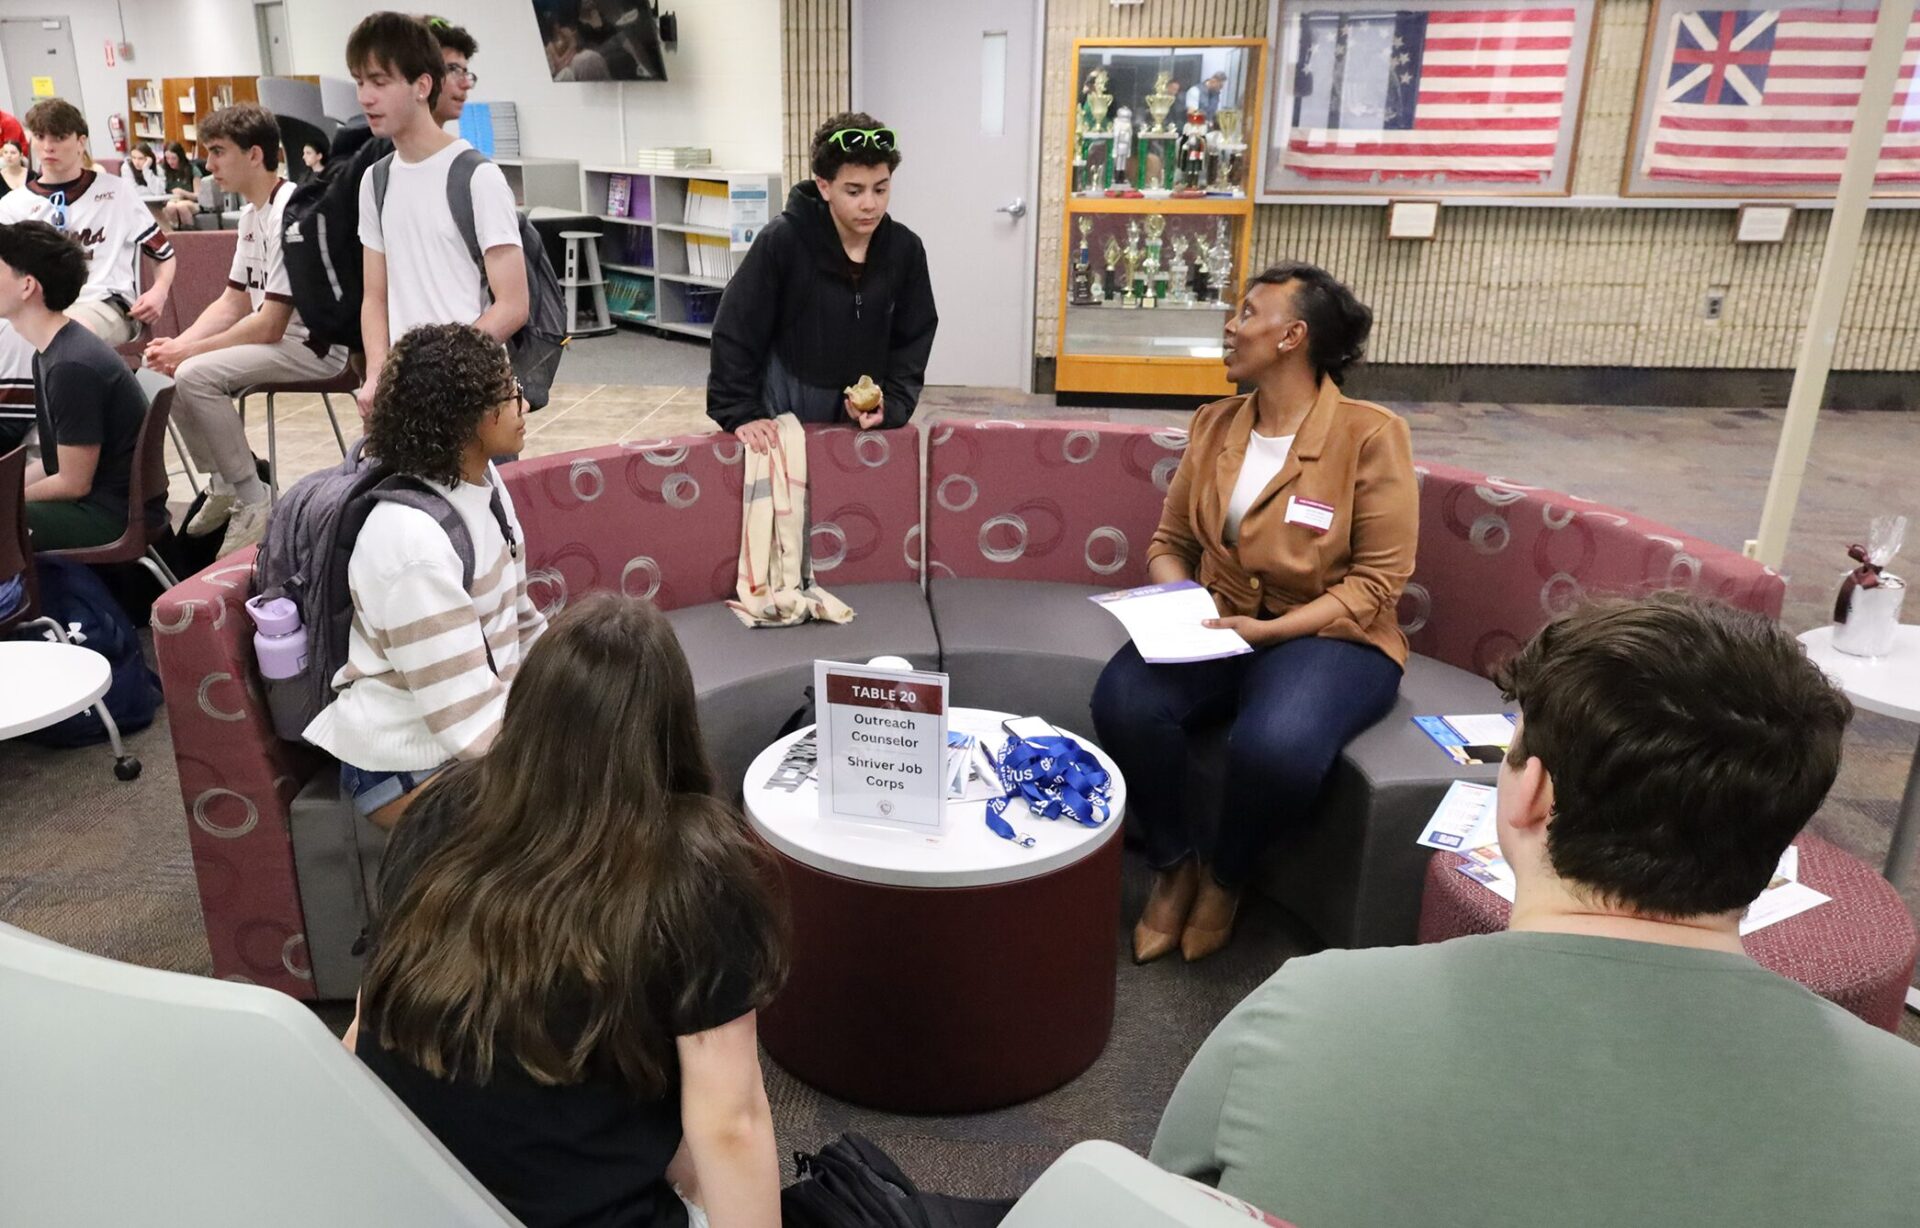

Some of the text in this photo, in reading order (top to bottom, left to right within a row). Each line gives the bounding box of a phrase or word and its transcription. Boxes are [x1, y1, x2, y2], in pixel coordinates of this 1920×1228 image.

[852, 686, 917, 703] TABLE 20
[854, 713, 916, 730] Outreach
[851, 731, 919, 748] Counselor
[847, 756, 923, 775] Shriver Job
[866, 775, 905, 791] Corps
